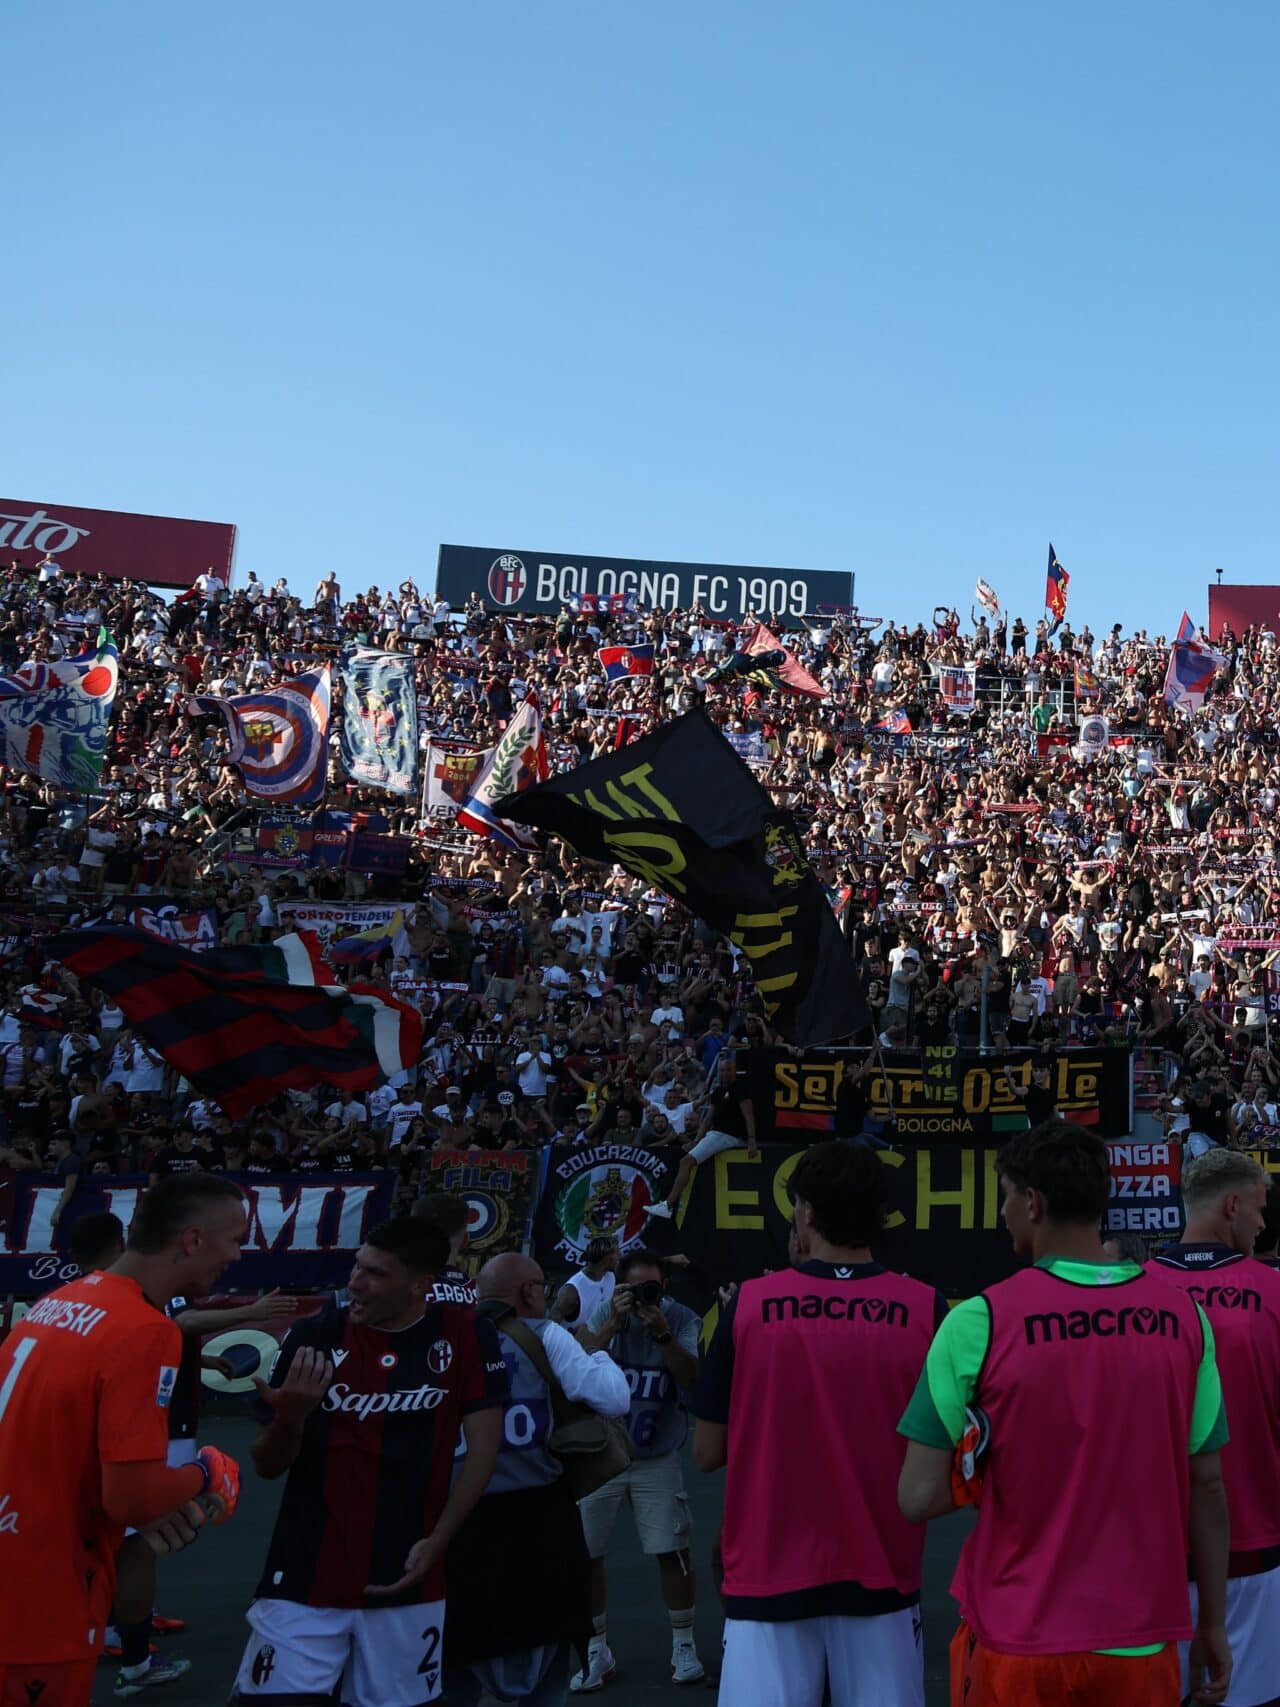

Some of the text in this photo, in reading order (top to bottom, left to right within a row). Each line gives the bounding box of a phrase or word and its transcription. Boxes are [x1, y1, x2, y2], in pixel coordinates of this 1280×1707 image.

[0, 510, 91, 553] uto
[536, 563, 808, 617] BOLOGNA FC 1909
[424, 804, 457, 817] VEN
[141, 912, 215, 941] SALA
[289, 908, 406, 922] CONTROTENDEN
[896, 1117, 973, 1133] BOLOGNA
[442, 1166, 511, 1191] FILA
[555, 1144, 669, 1179] EDUCAZIONE
[1108, 1206, 1181, 1230] BERO
[763, 1294, 907, 1328] macron
[1186, 1287, 1259, 1312] cron
[27, 1298, 108, 1337] ORUPSKI
[1024, 1306, 1178, 1345] macron
[321, 1384, 449, 1422] Saputo
[417, 1626, 439, 1674] 2
